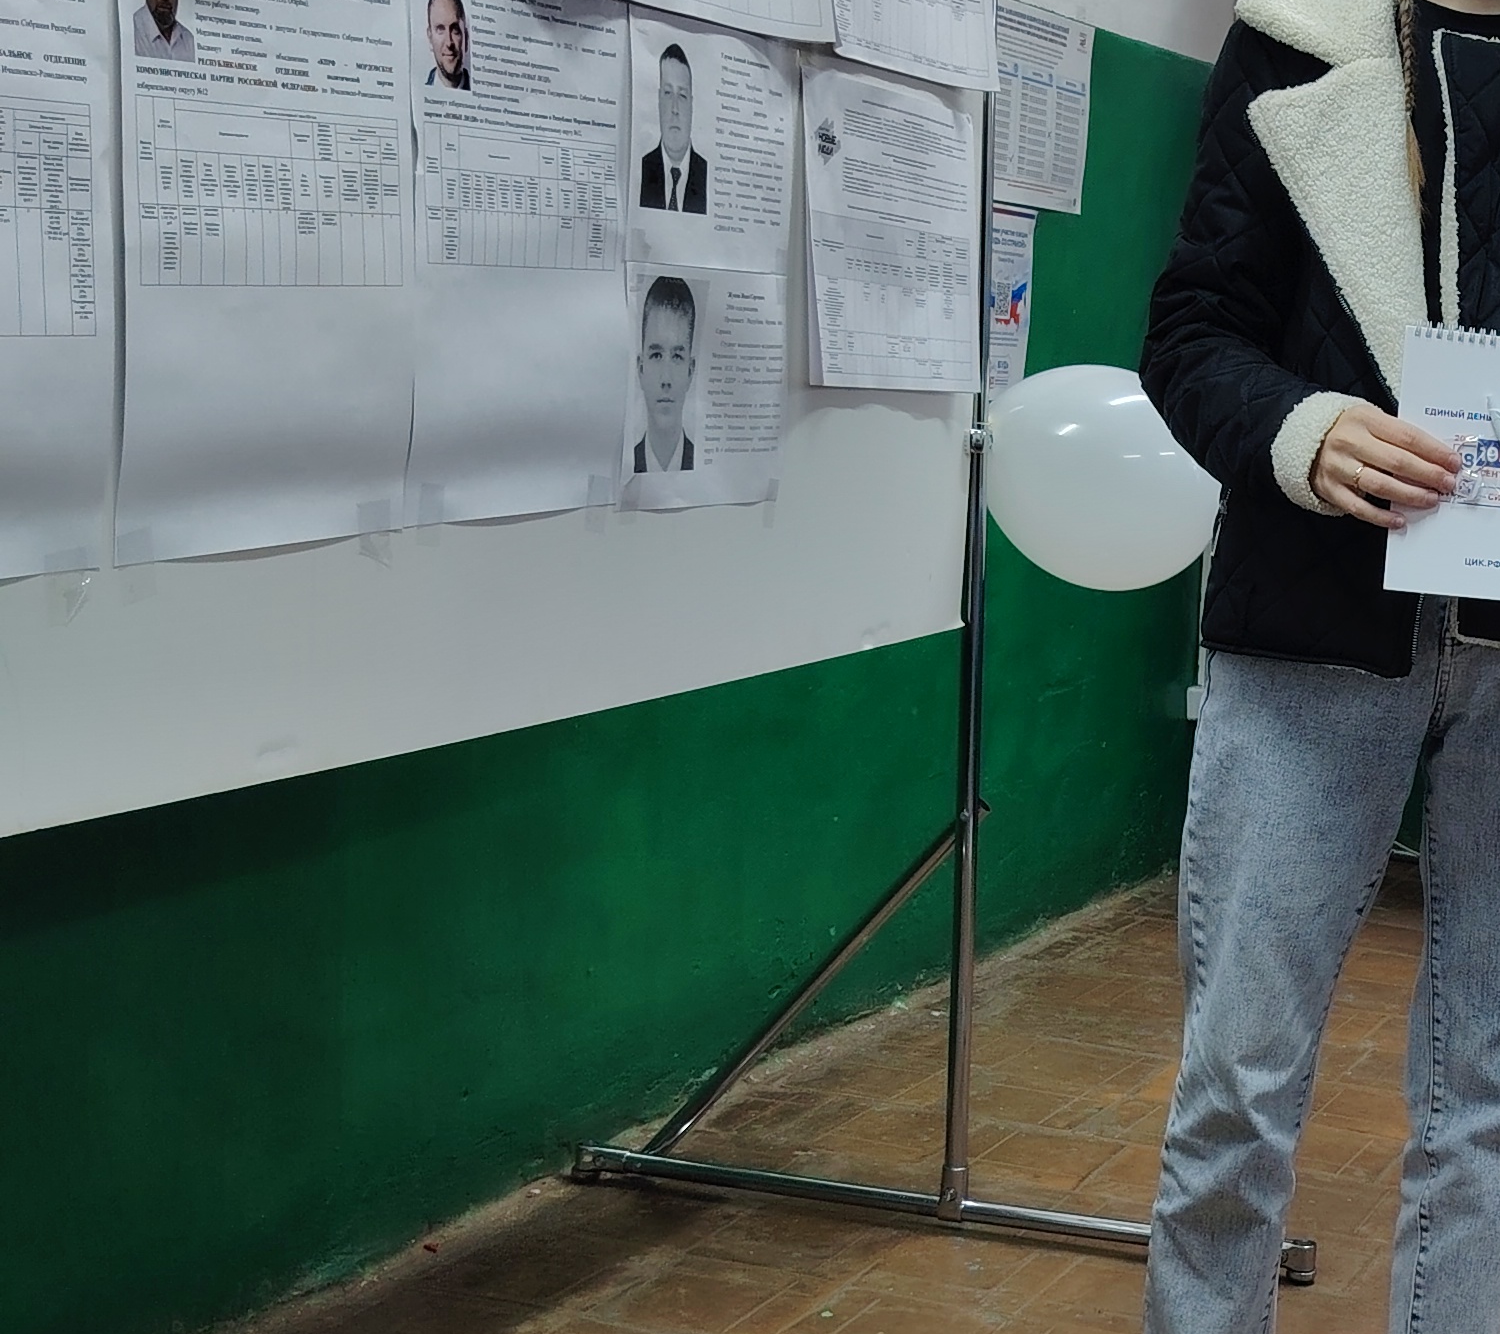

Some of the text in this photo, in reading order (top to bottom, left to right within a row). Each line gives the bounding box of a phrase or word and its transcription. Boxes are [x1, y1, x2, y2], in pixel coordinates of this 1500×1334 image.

[1425, 407, 1465, 420] ЕДИНЫЙ
[1467, 412, 1492, 422] ДЕНЬ
[1464, 558, 1500, 568] ЦИК.РФ
